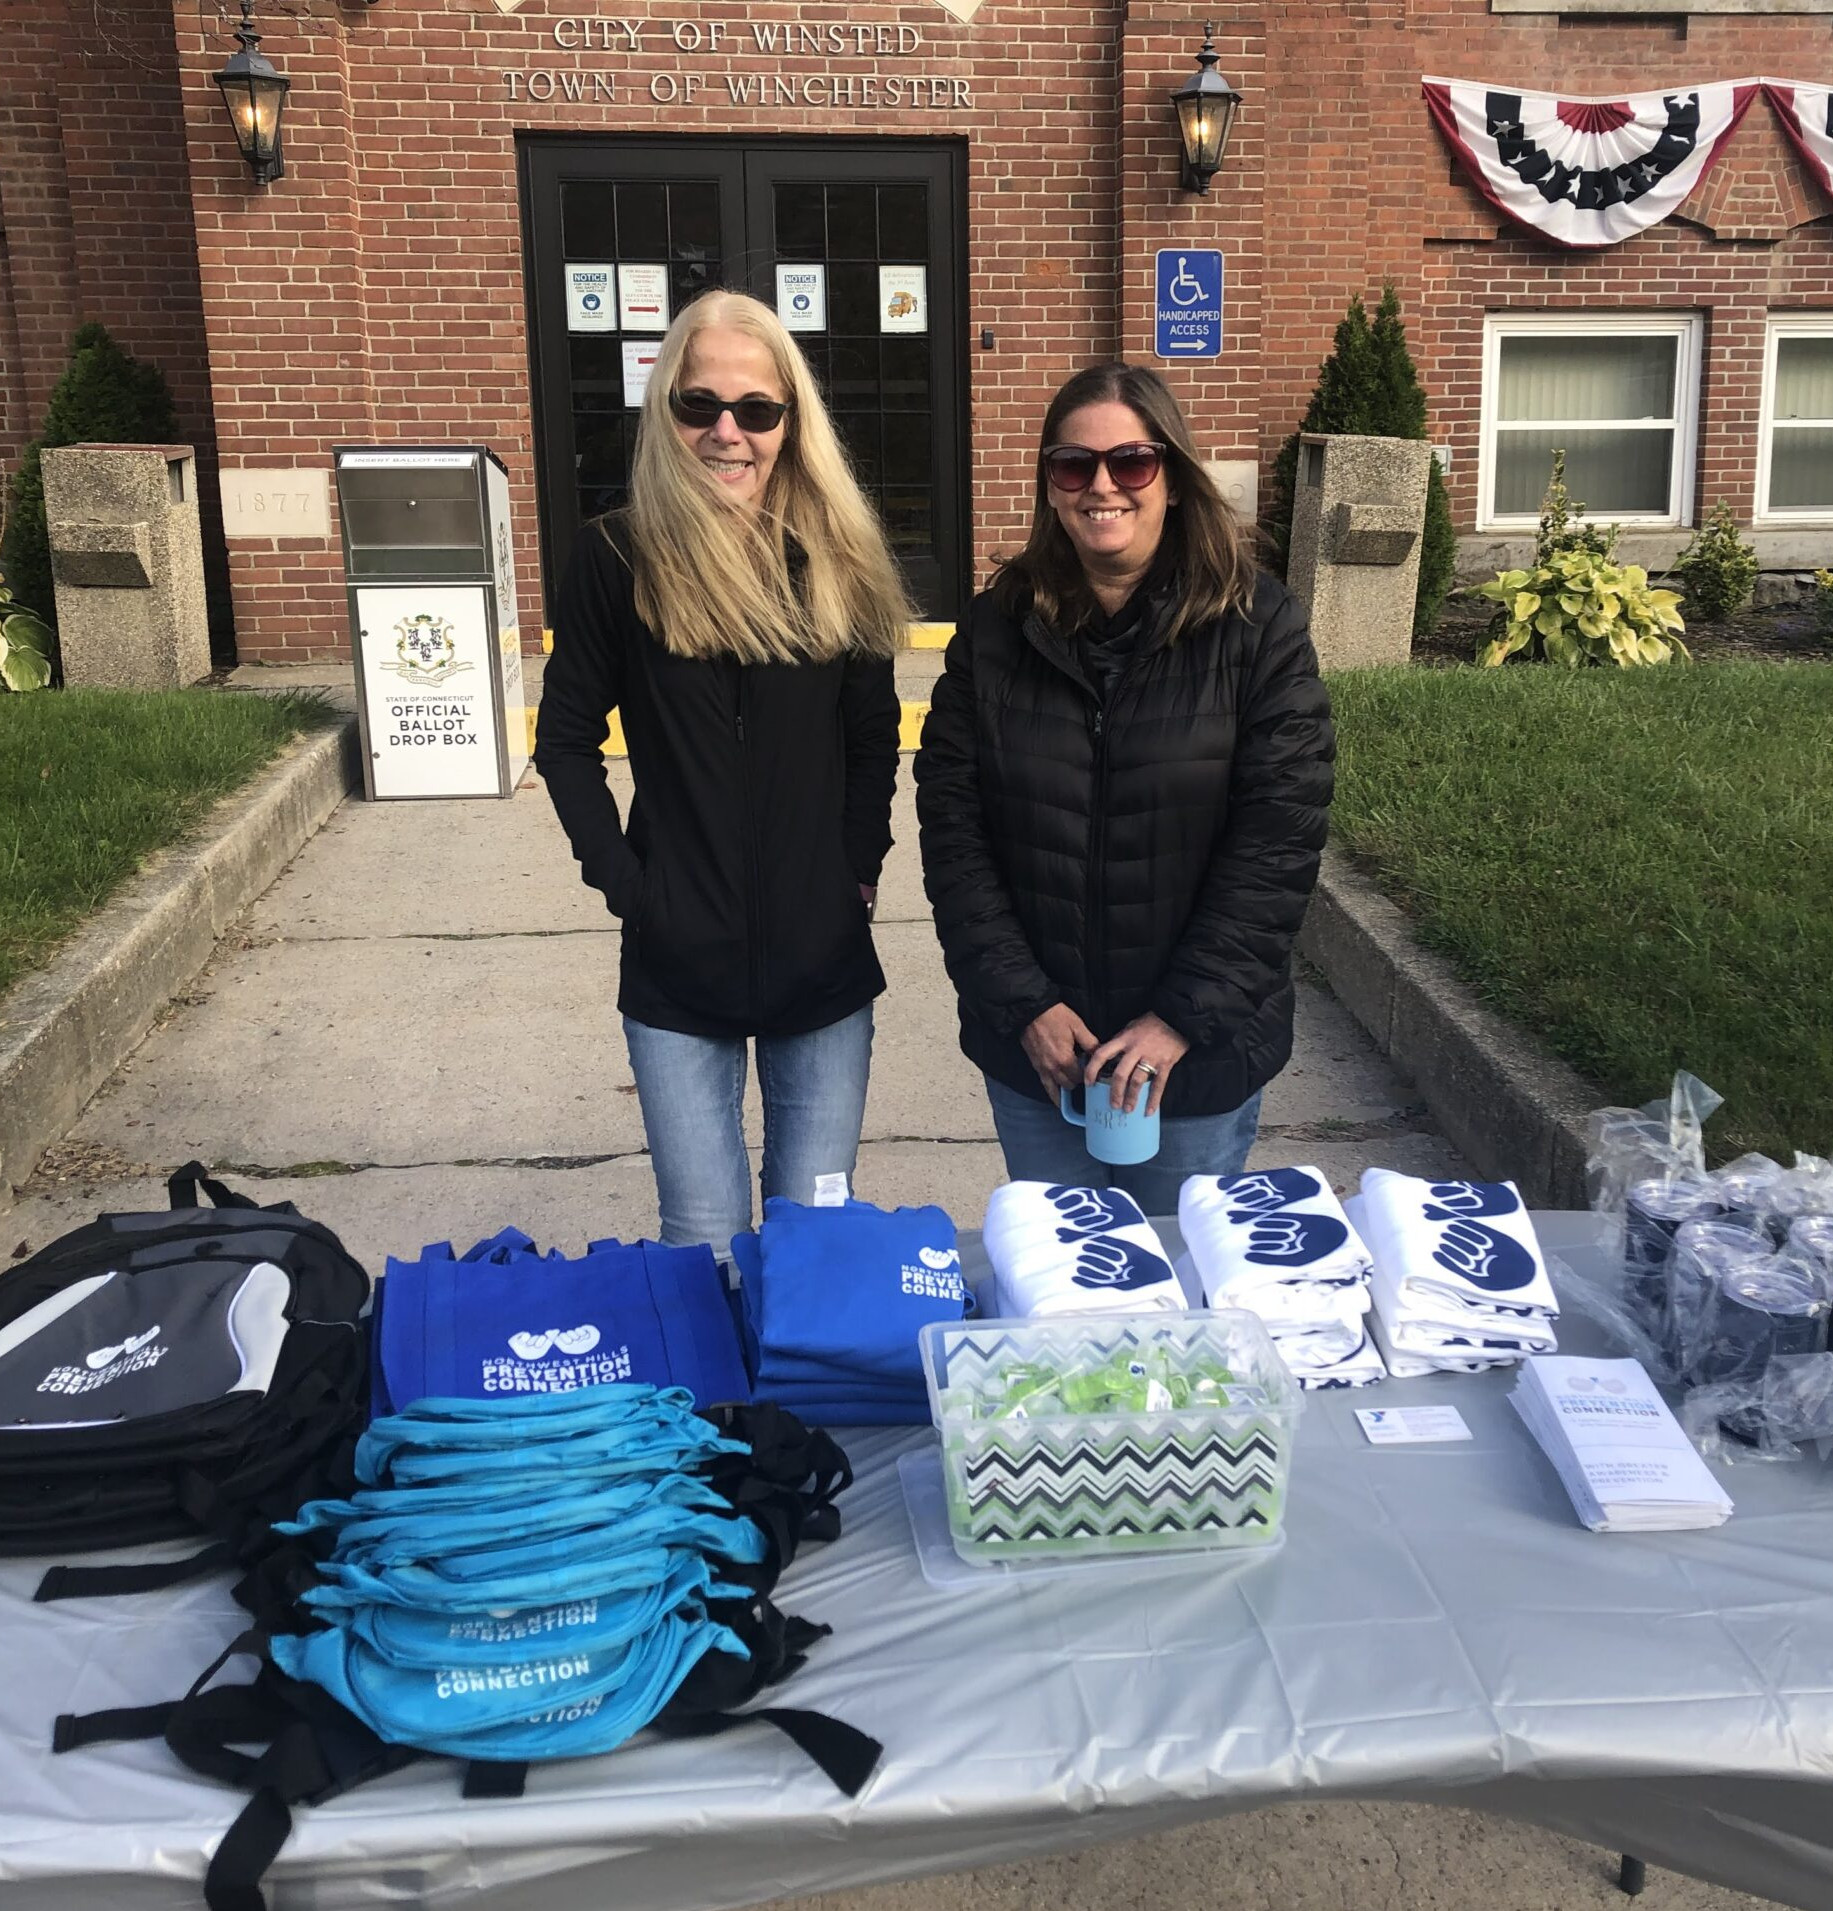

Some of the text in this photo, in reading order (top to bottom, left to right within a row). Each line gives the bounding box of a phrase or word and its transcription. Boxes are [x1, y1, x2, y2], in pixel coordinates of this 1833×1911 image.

[554, 18, 920, 54] CITY OF WINSTED
[502, 70, 974, 108] TOWN OF WINCHESTER
[574, 273, 607, 282] NOTICE
[786, 275, 815, 283] NOTICE
[1159, 310, 1220, 321] HANDICAPPED
[1169, 324, 1210, 335] ACCESS
[236, 492, 310, 513] 1877
[391, 705, 471, 717] OFFICIAL
[400, 719, 465, 731] BALLOT
[390, 733, 478, 746] DROP BOX
[901, 1271, 964, 1290] PREVE
[482, 1345, 629, 1370] NORTHWEST HILLS
[483, 1353, 631, 1382] PREVENTION
[36, 1357, 160, 1395] CONNECTION
[43, 1350, 164, 1386] PREVENTION
[483, 1365, 632, 1394] CONNECTION
[1563, 1407, 1661, 1417] CONNECTION
[437, 1659, 590, 1699] CONNECTION
